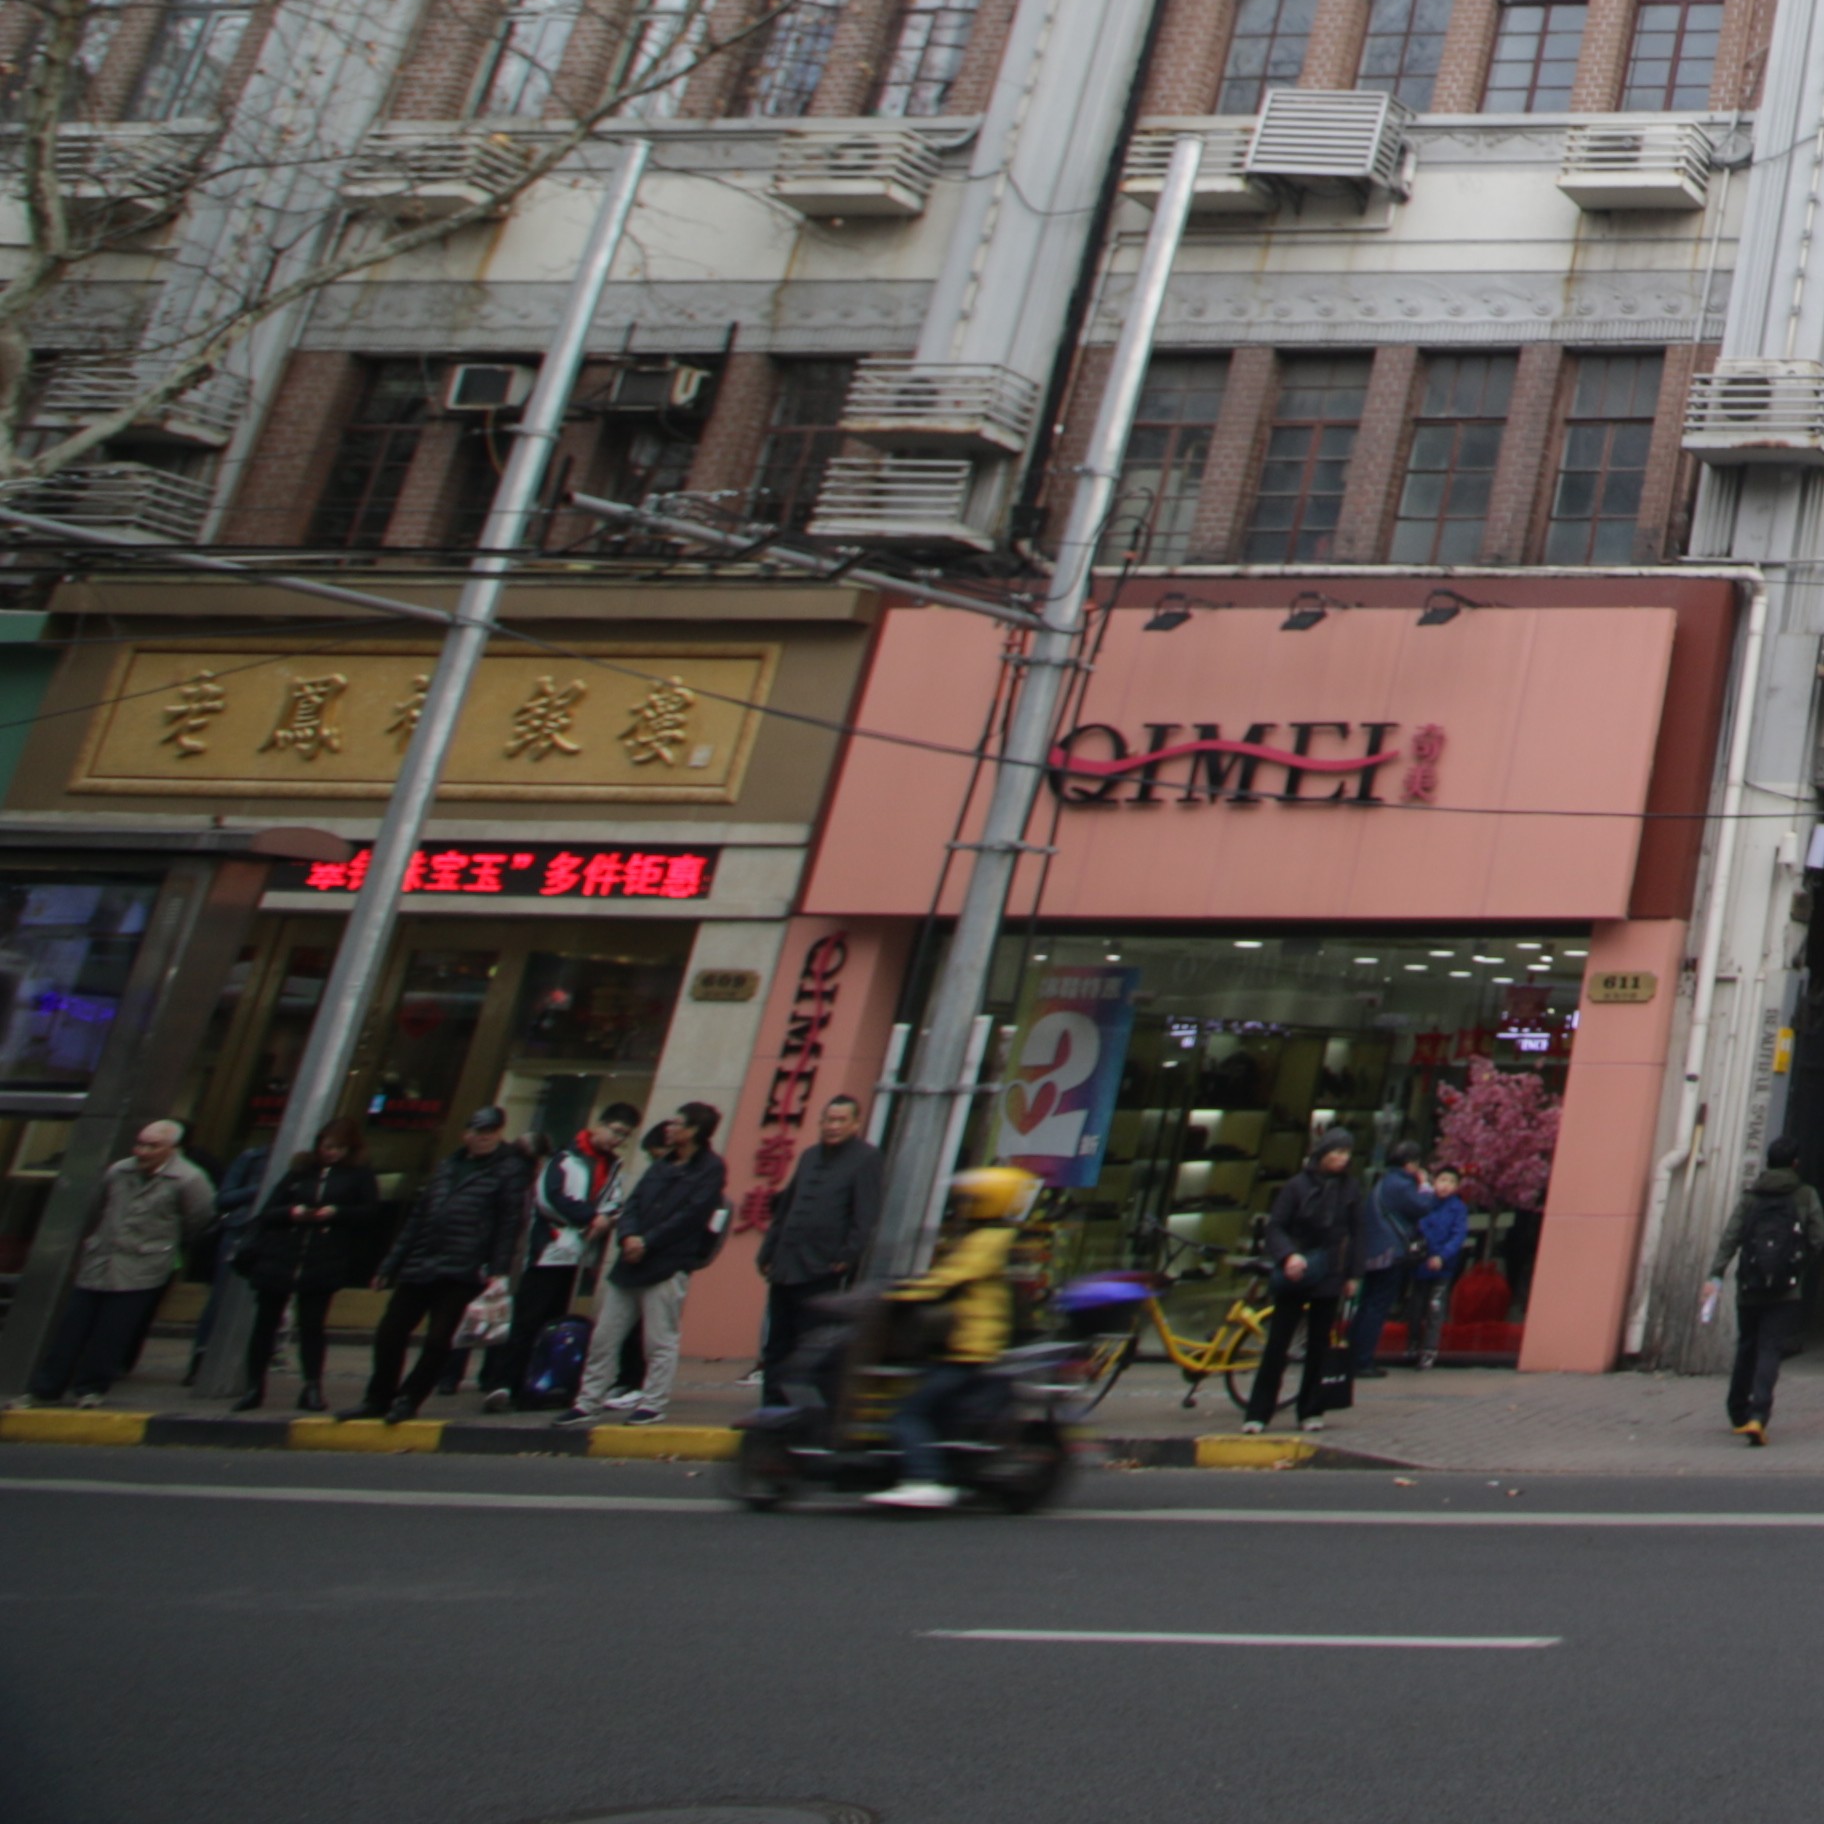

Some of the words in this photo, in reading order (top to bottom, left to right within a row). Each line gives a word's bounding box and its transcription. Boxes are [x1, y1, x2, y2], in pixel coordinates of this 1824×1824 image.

[1046, 722, 1402, 805] QIMEI
[1603, 975, 1640, 989] 611
[761, 933, 848, 1128] QIMEI
